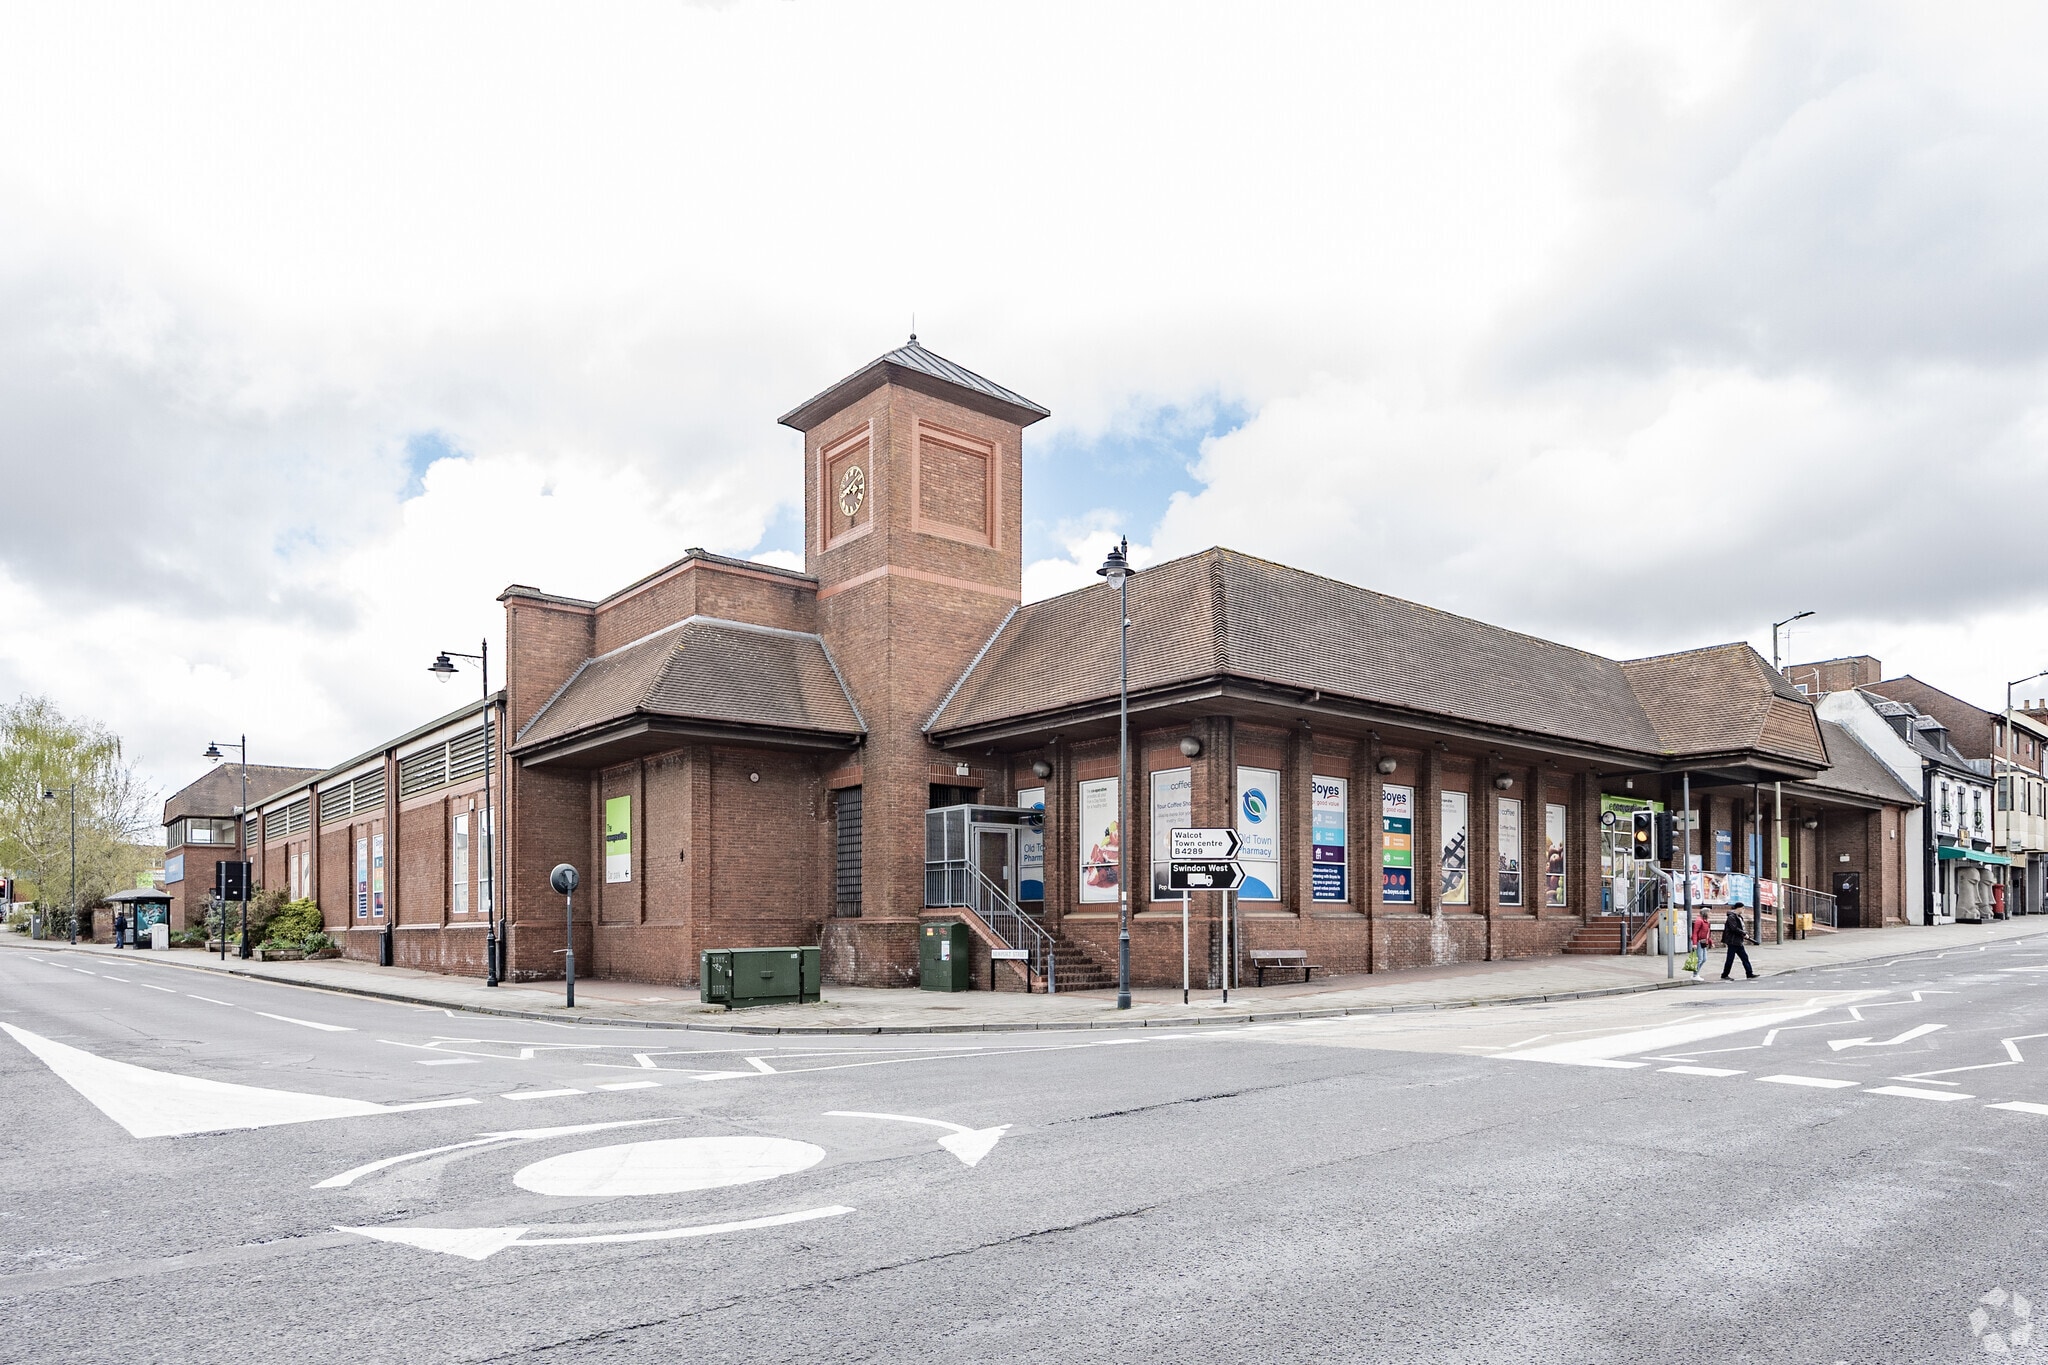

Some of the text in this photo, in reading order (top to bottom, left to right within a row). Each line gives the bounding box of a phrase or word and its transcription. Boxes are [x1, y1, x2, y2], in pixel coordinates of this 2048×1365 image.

[1171, 780, 1191, 790] coffee
[1252, 835, 1272, 845] Town
[1024, 844, 1035, 852] Old
[1024, 854, 1043, 862] Pharm
